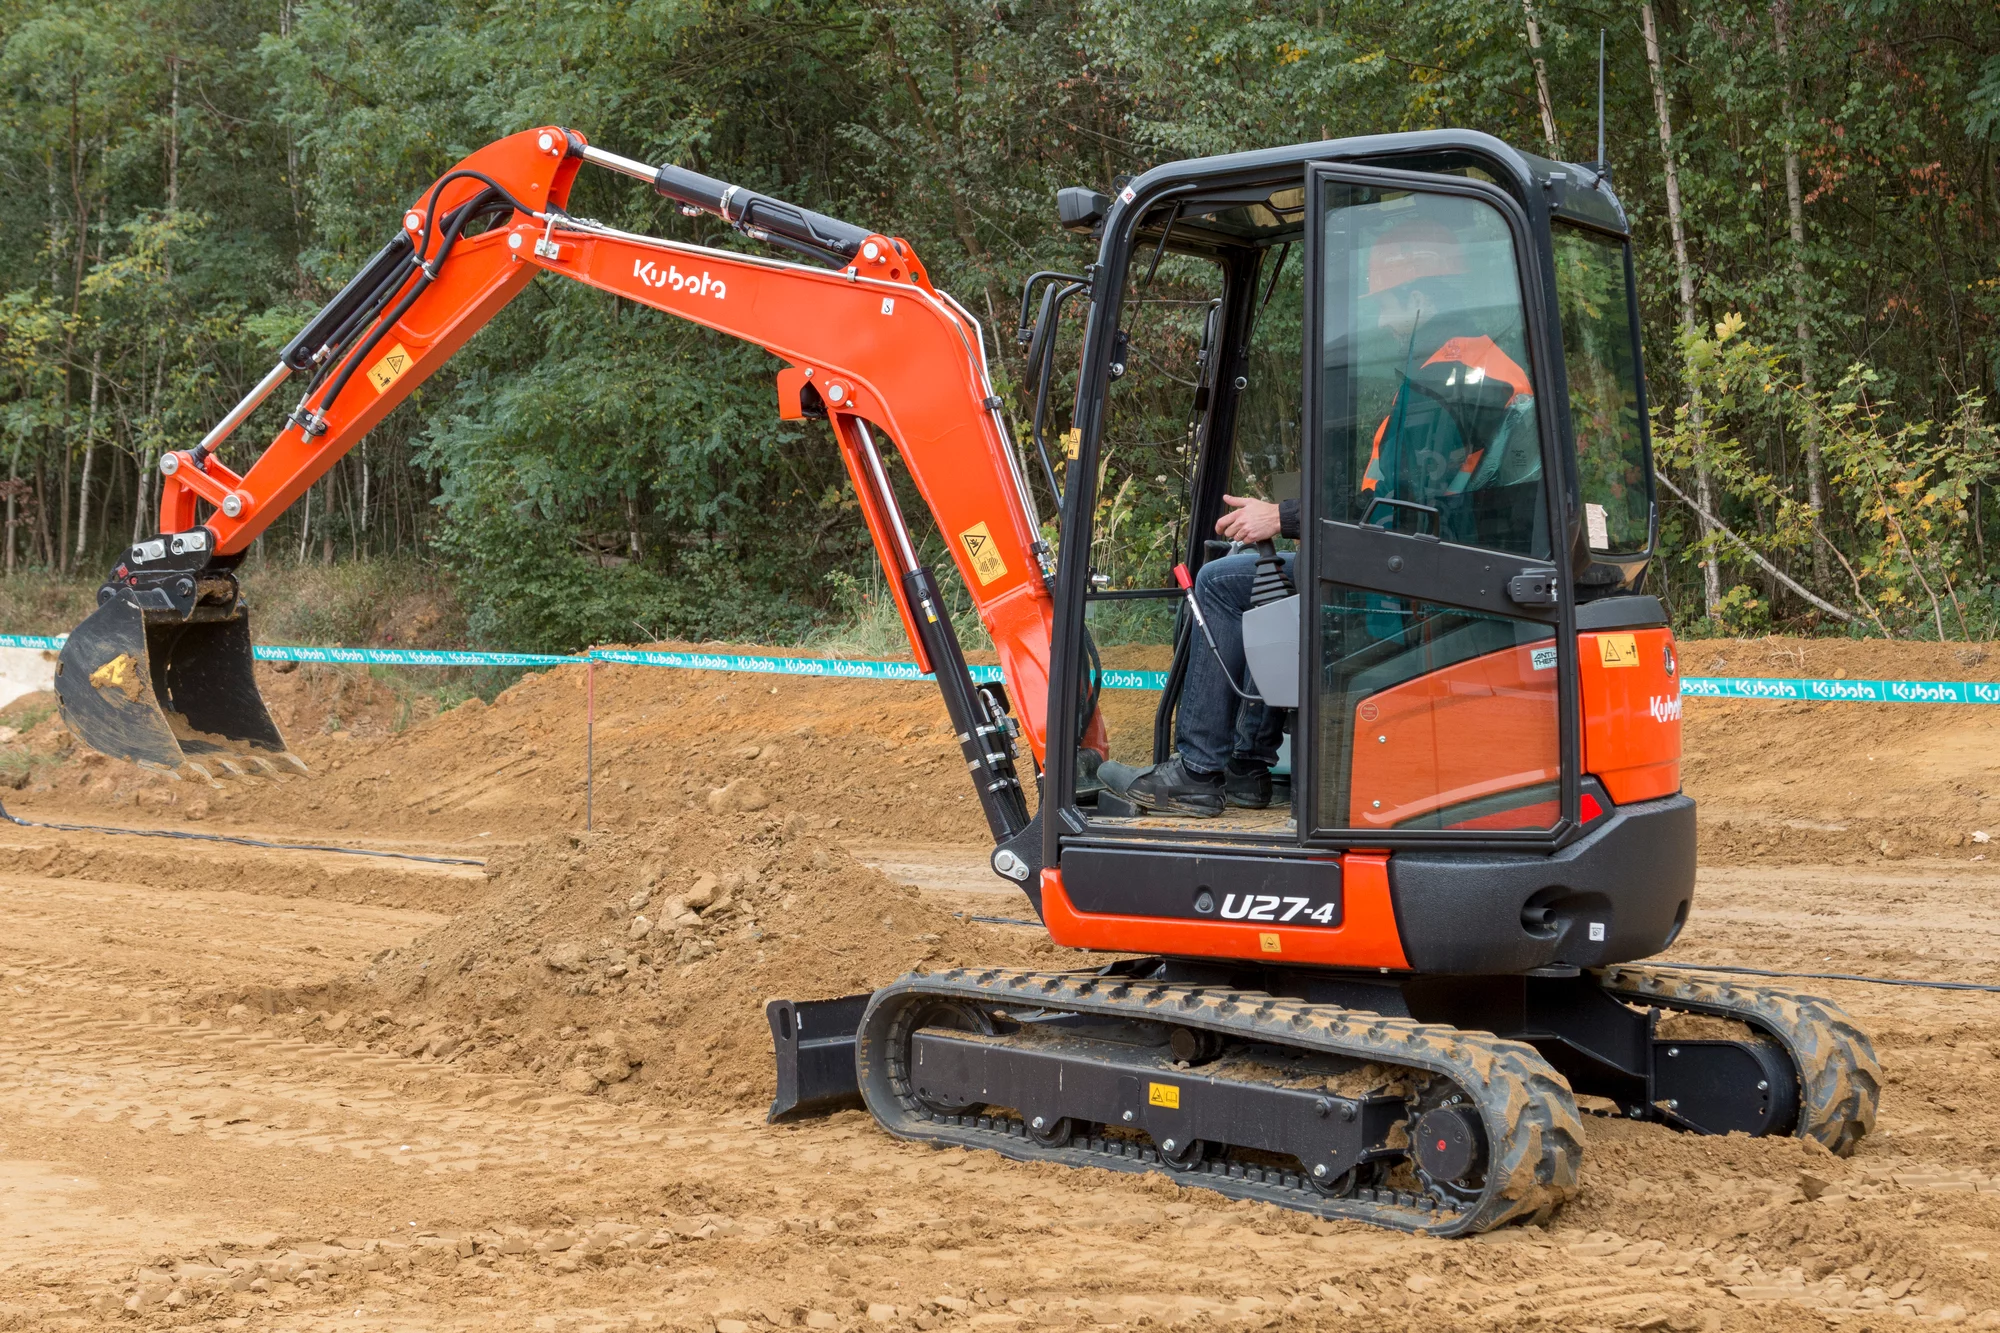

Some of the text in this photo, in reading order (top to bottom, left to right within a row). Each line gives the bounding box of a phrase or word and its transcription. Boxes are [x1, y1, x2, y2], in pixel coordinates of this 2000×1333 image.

[633, 259, 726, 299] Kubota
[257, 647, 288, 659] Kubota
[294, 649, 326, 660] Kubota
[331, 650, 364, 661] Kubota
[370, 651, 403, 663] Kubota
[408, 652, 443, 663] Kubota
[602, 651, 637, 662] Kubota
[646, 653, 682, 666] Kubota
[691, 655, 728, 668] Kubota
[738, 658, 775, 671] Kubota
[785, 659, 824, 674] Kubota
[834, 661, 873, 676] Kubota
[884, 663, 924, 678] Kubota
[1680, 679, 1721, 694] bota
[1735, 680, 1797, 697] Kubota
[1812, 681, 1877, 699] Kubota
[1892, 683, 1957, 700] Kubota
[1220, 893, 1335, 924] U27-4
